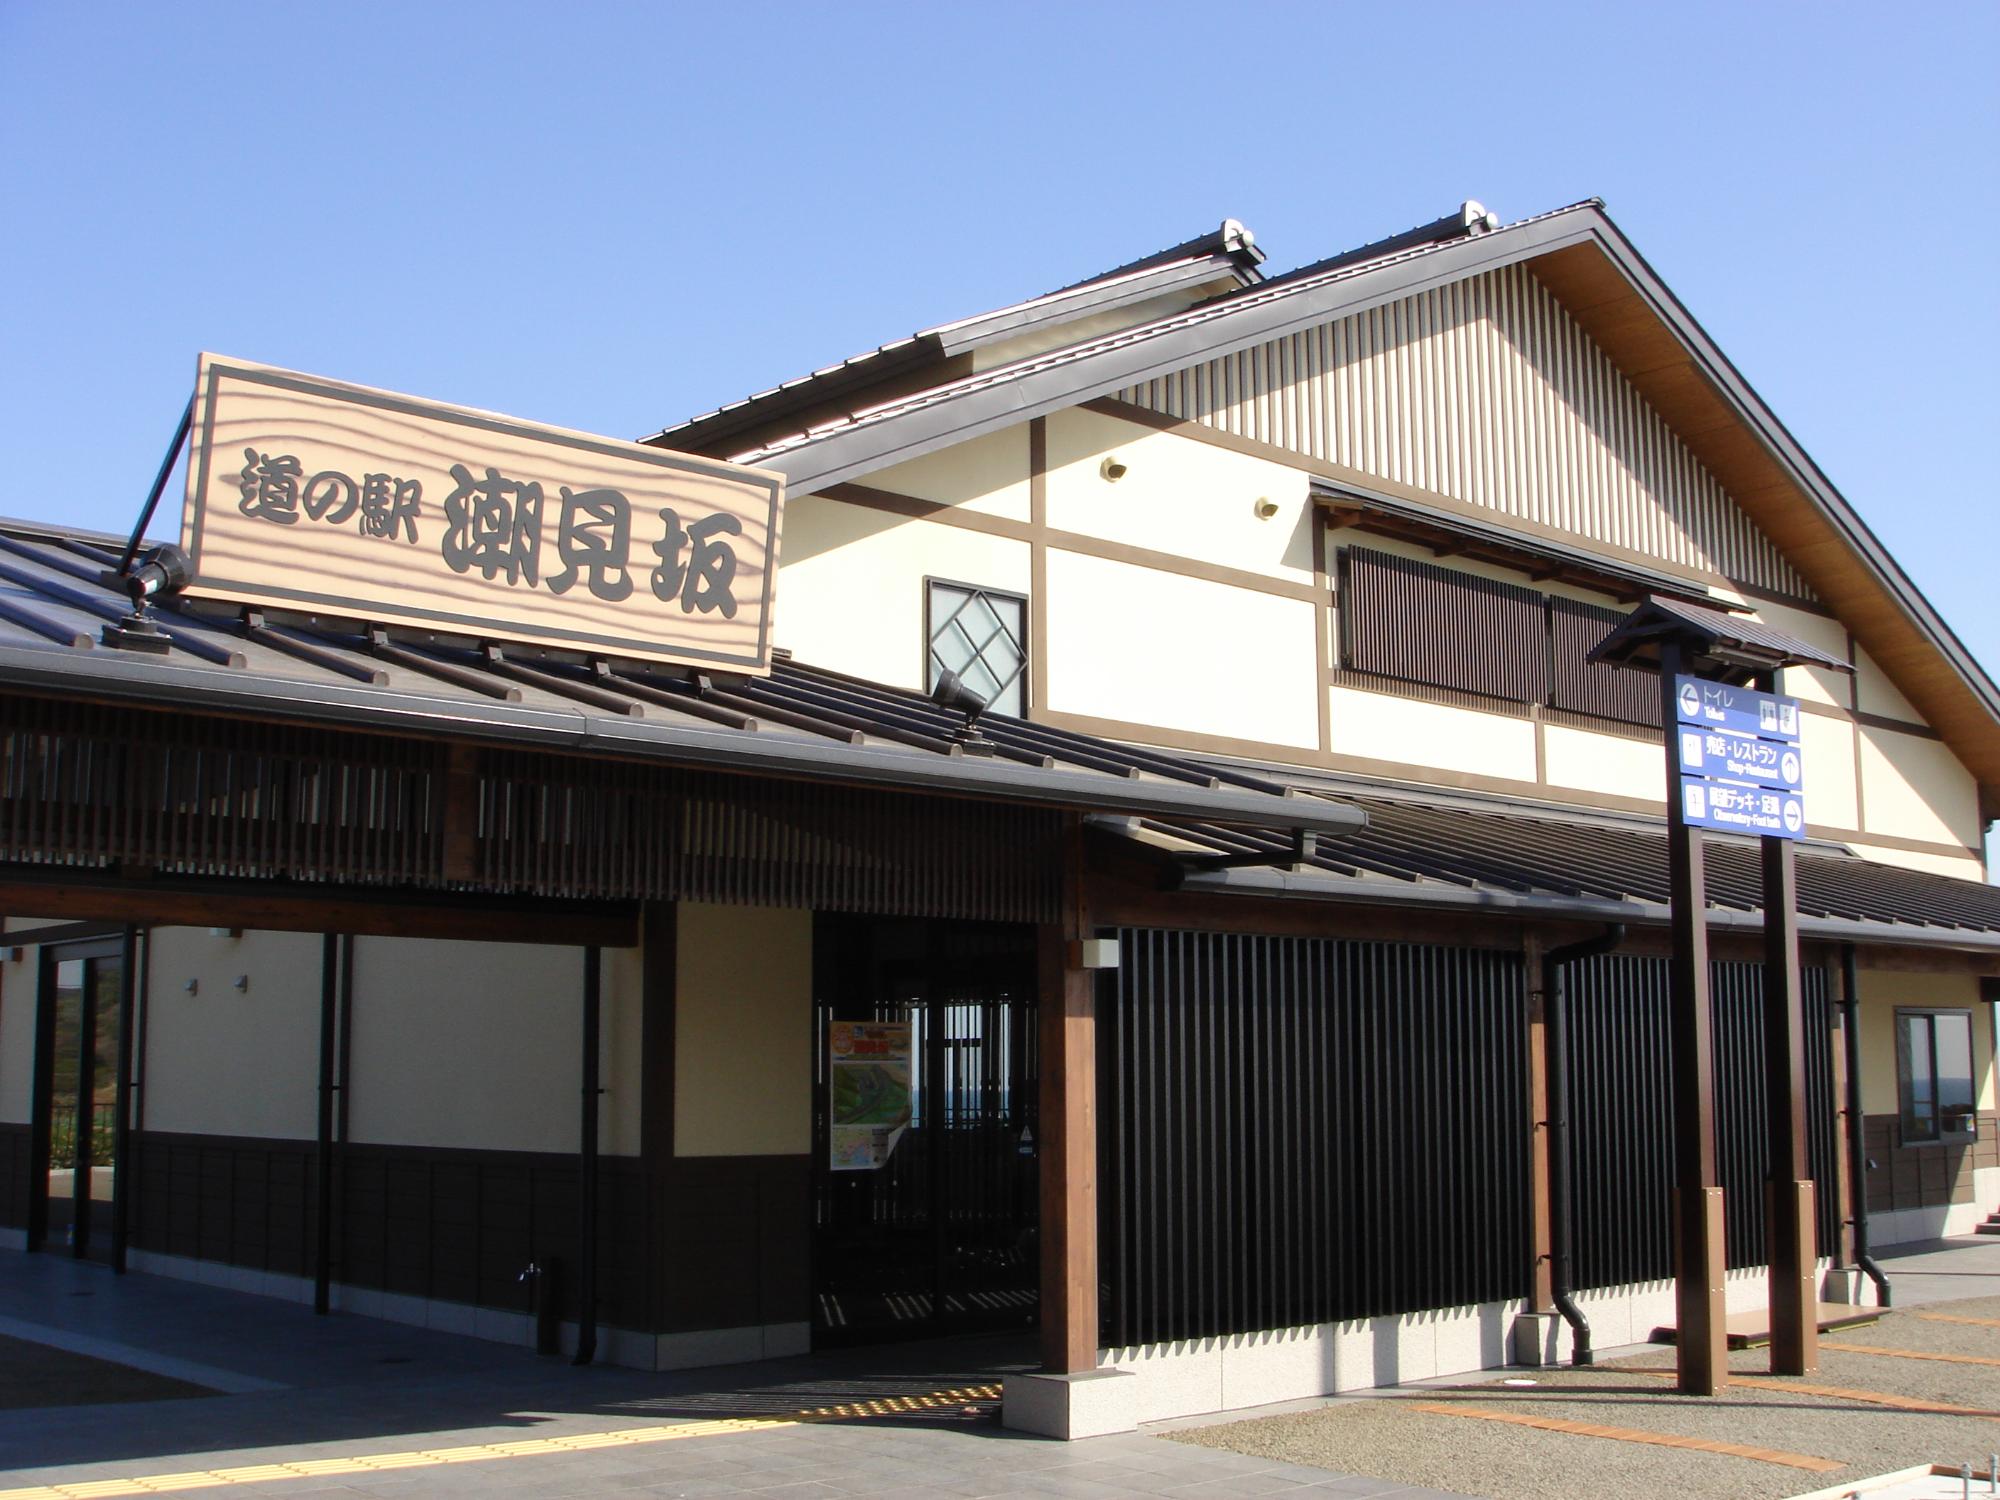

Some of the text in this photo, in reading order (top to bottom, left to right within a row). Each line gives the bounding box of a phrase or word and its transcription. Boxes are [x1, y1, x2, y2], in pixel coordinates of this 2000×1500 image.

[238, 447, 743, 620] 道の駅 潮見坂
[1704, 685, 1734, 708] トイレ
